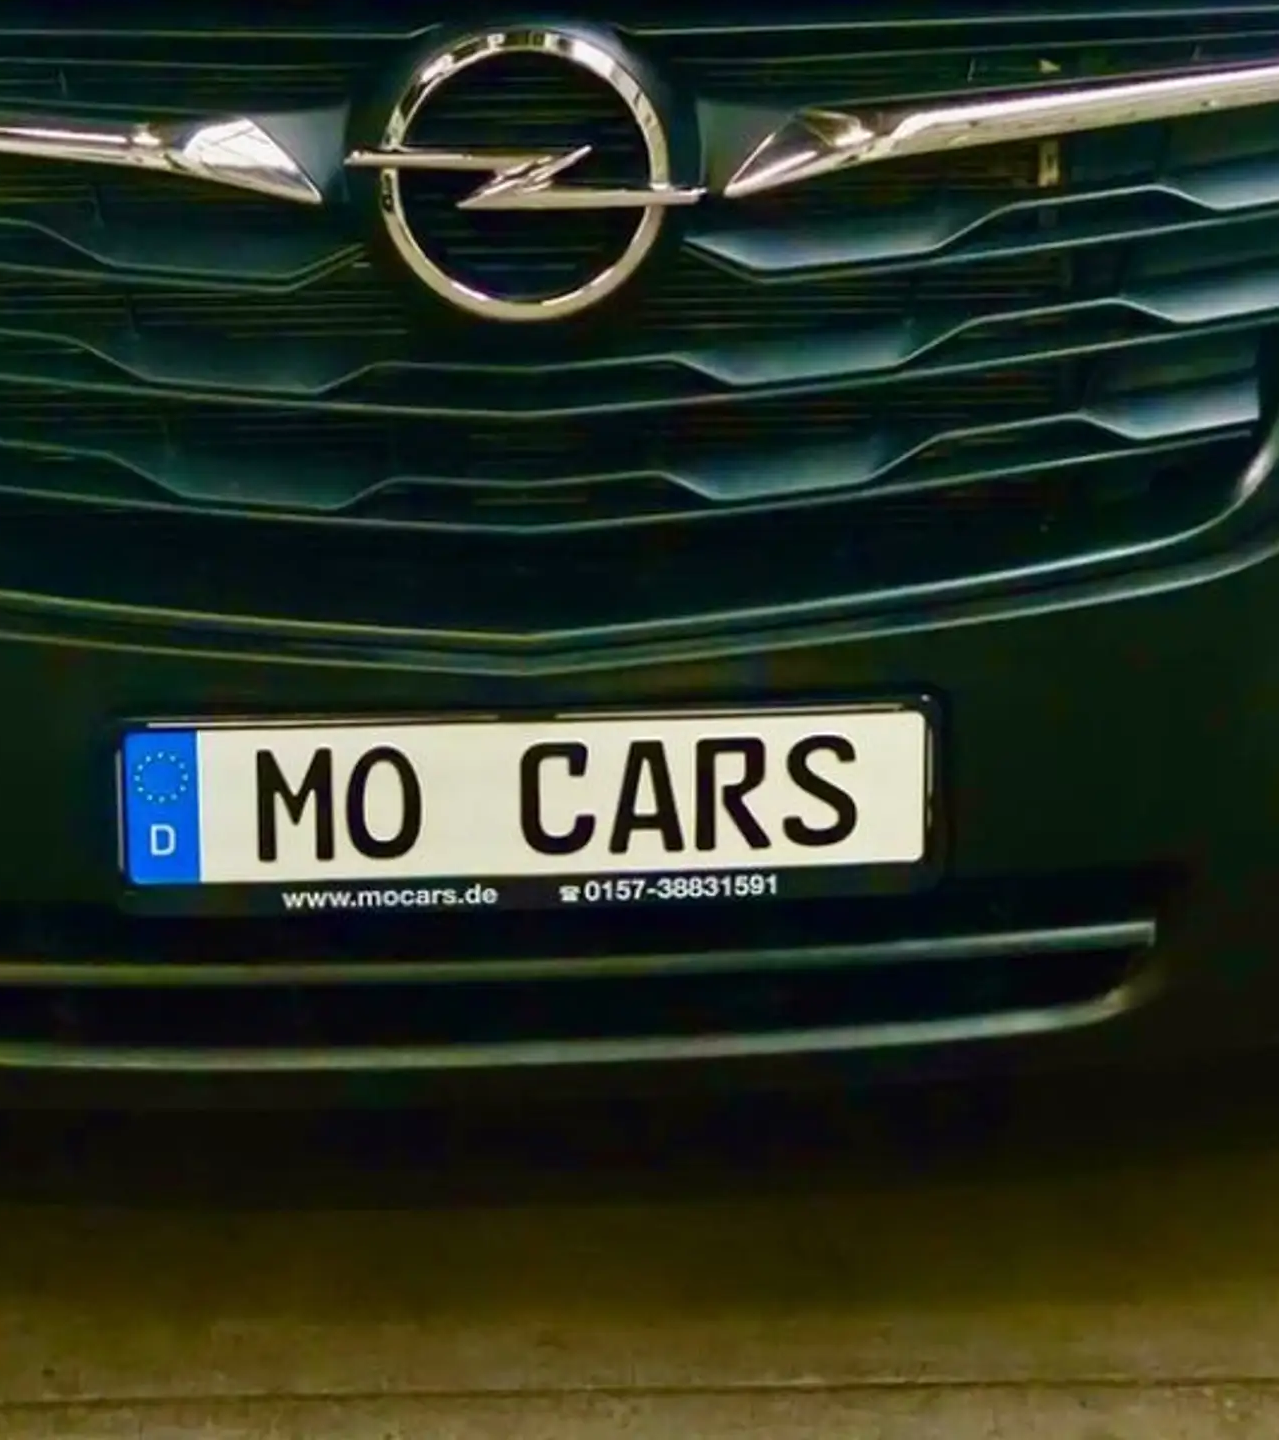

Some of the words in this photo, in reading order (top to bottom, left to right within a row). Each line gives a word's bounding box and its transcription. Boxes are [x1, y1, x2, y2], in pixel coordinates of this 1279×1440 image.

[255, 746, 423, 864] MO
[520, 734, 859, 855] CARS
[150, 823, 176, 857] D
[282, 883, 499, 909] www.mocars.de
